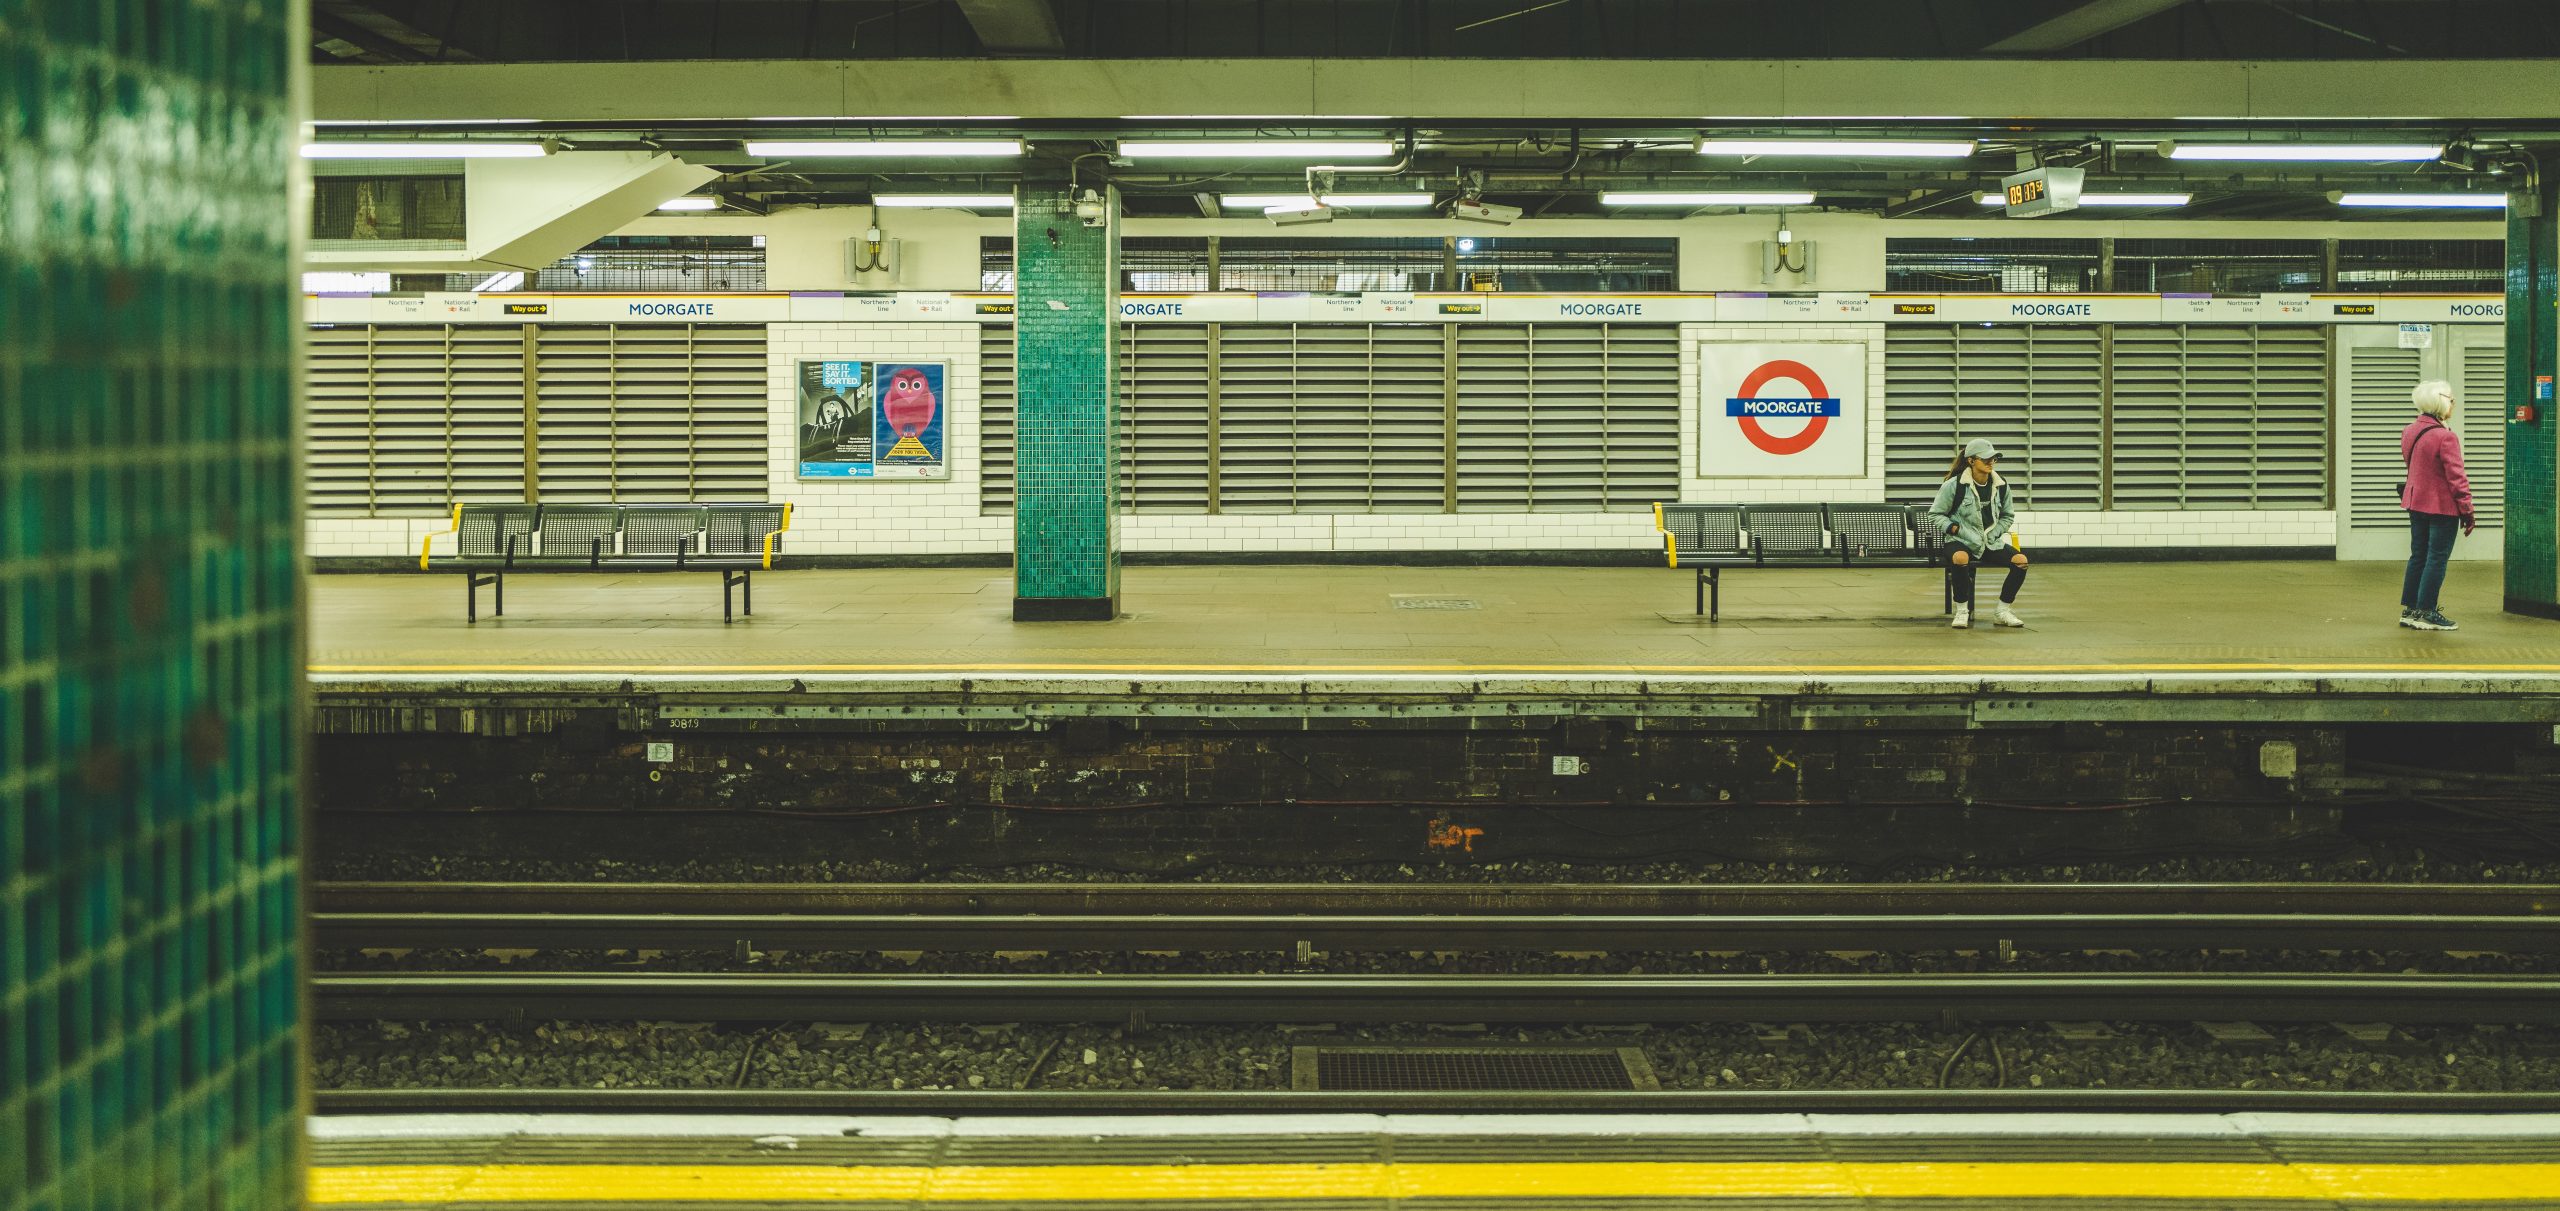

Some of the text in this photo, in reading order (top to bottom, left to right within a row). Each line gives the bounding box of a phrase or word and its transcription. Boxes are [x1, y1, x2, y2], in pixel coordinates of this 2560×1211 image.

[512, 305, 526, 313] Way
[630, 303, 714, 316] MOORGATE
[984, 305, 998, 313] Way
[1120, 303, 1183, 316] ORGATE
[1447, 305, 1462, 313] Way
[1561, 303, 1642, 316] MOORGATE
[1901, 305, 1916, 313] Way
[2012, 303, 2091, 316] MOORGATE
[2341, 305, 2355, 313] Way
[2451, 304, 2504, 316] MOORG
[825, 363, 851, 371] SEE IT.
[825, 370, 851, 378] SAY IT.
[825, 377, 860, 385] SORTED.
[1744, 402, 1822, 413] MOORGATE
